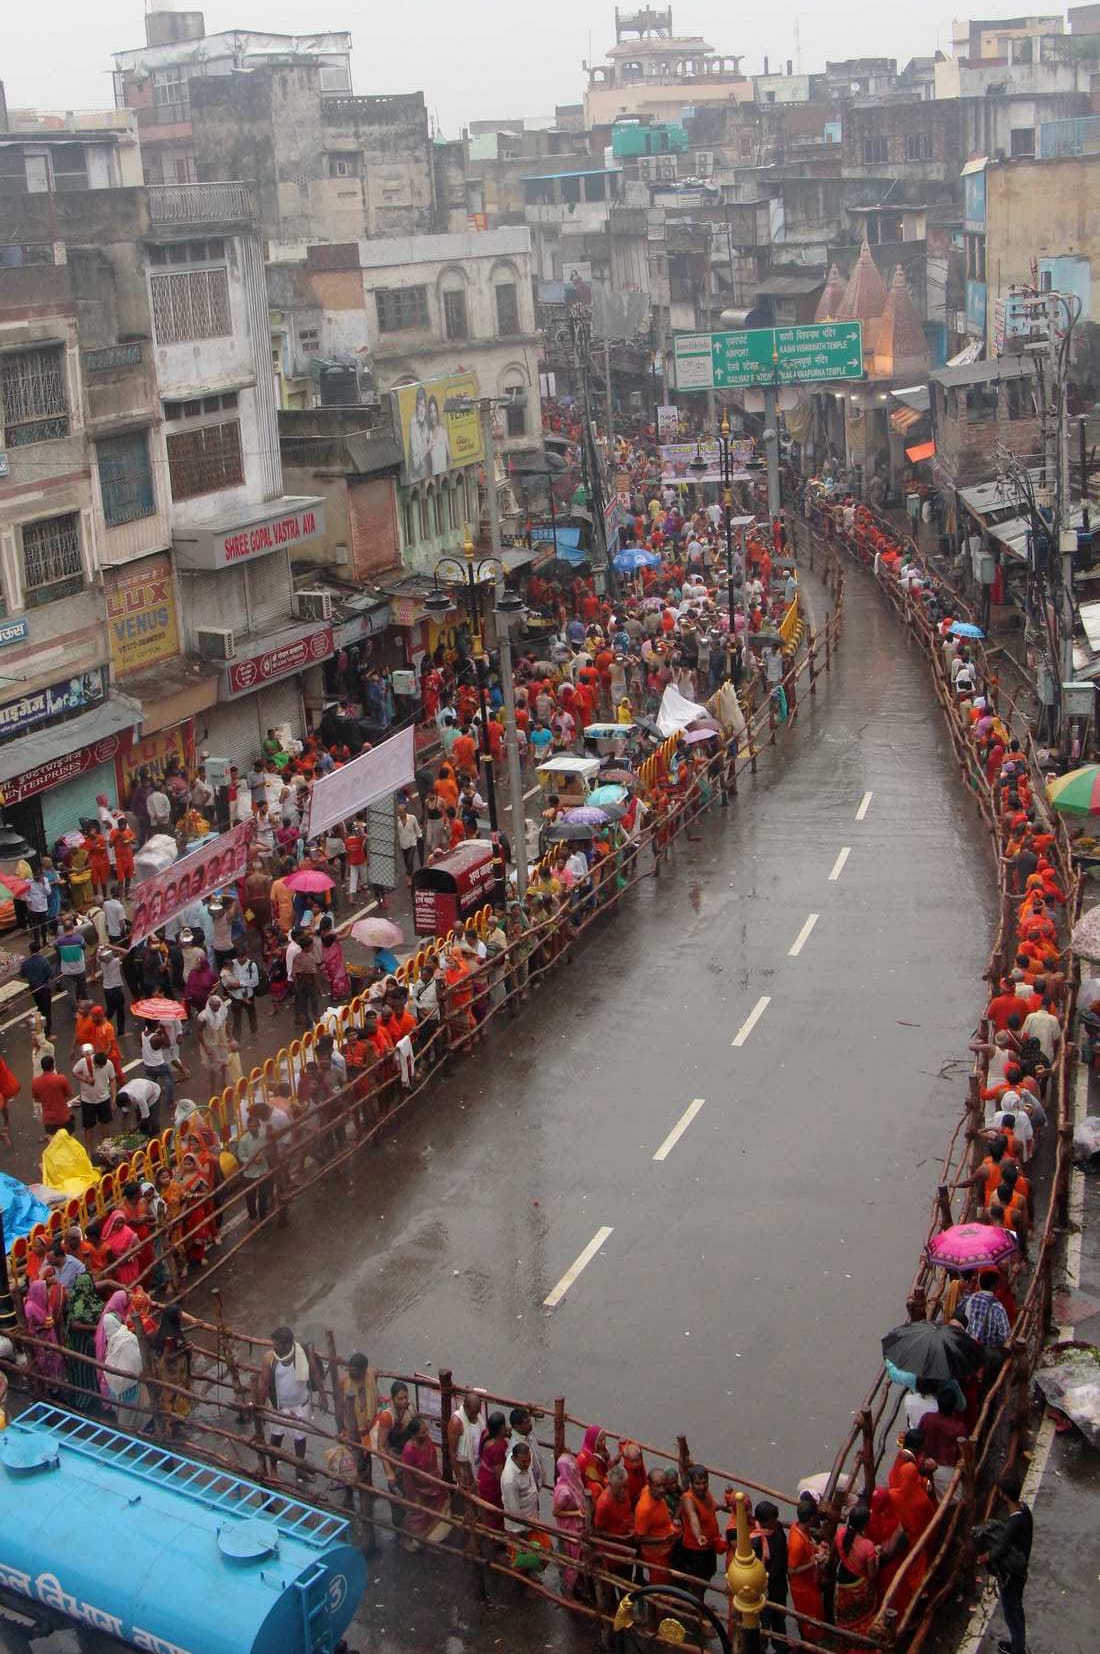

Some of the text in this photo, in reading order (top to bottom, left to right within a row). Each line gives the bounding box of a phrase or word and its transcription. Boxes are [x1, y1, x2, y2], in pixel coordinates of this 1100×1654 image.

[826, 339, 849, 351] TEMPLE
[726, 347, 749, 358] AIRPORT
[825, 366, 847, 376] TEMPLE
[727, 374, 750, 384] RAILWAY
[224, 511, 316, 560] SHREE GOPAL VASTRA AYA
[104, 579, 169, 619] LUX
[113, 606, 169, 640] VENUS
